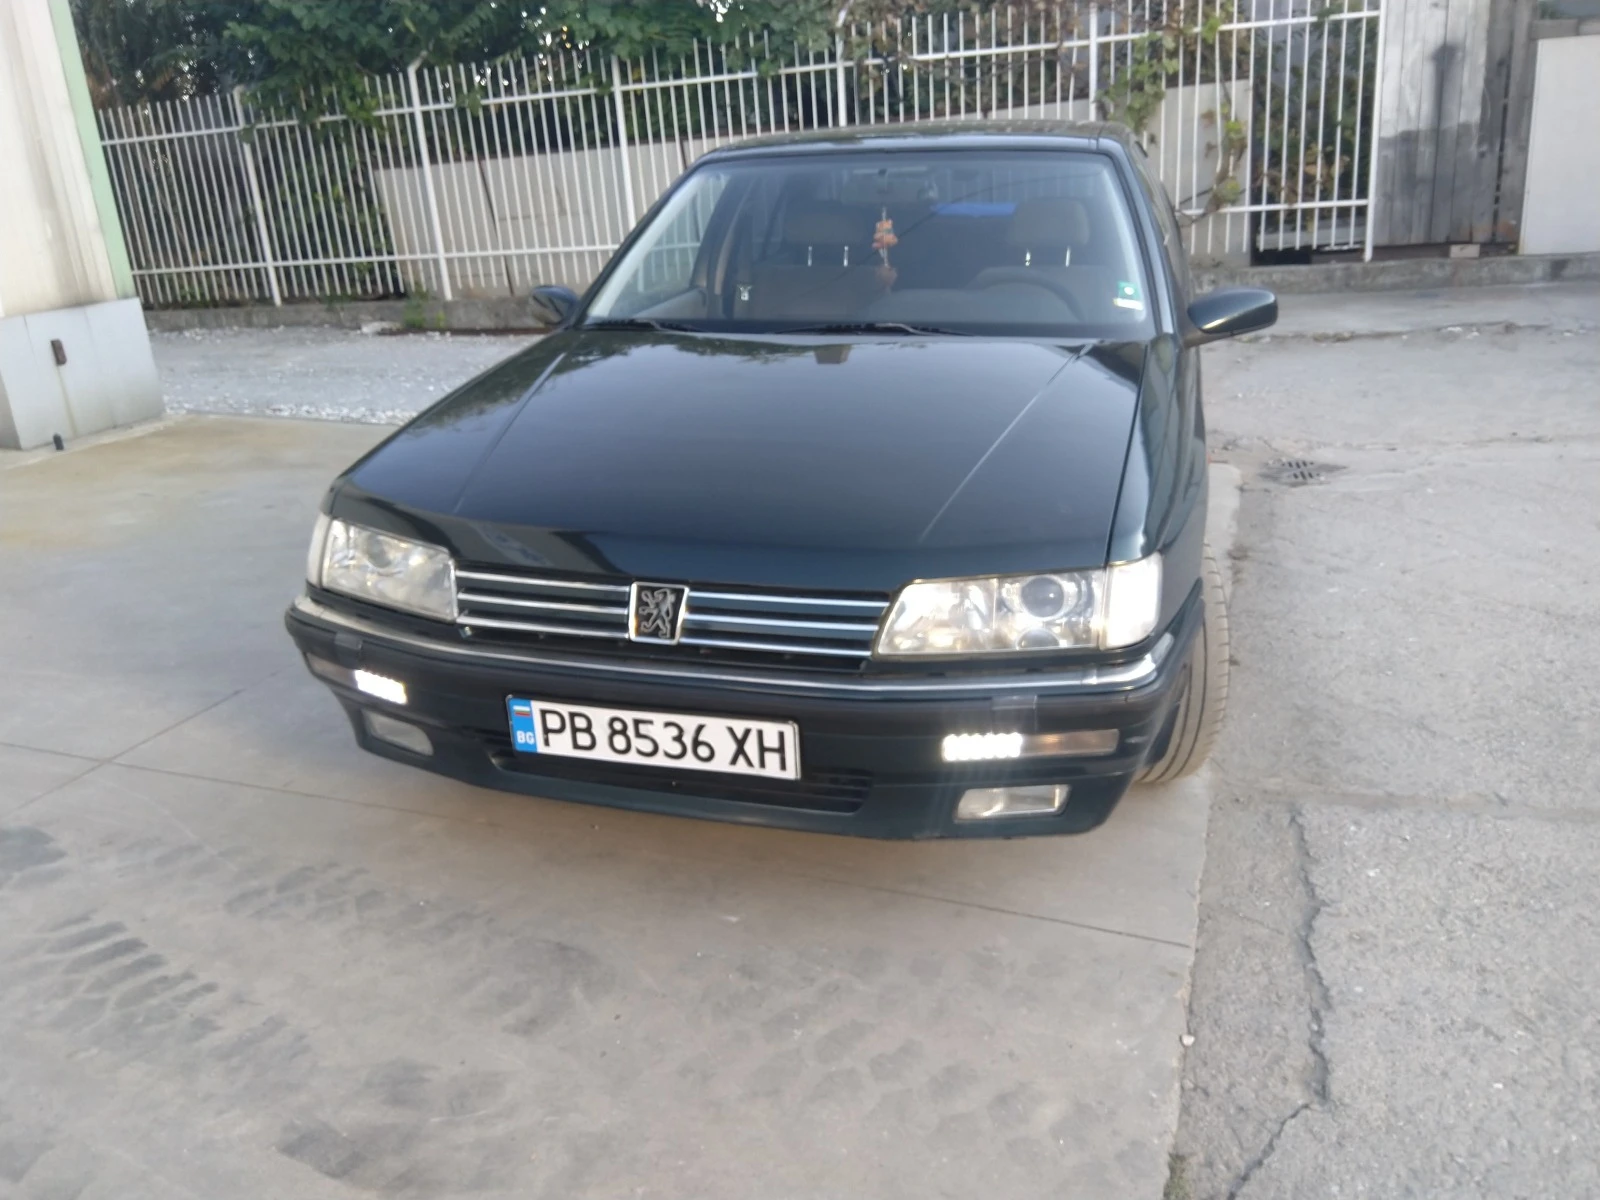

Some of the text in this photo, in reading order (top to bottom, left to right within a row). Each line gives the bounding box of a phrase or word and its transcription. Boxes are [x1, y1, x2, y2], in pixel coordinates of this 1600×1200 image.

[516, 730, 535, 745] BG
[539, 709, 787, 771] PB 8536 XH
